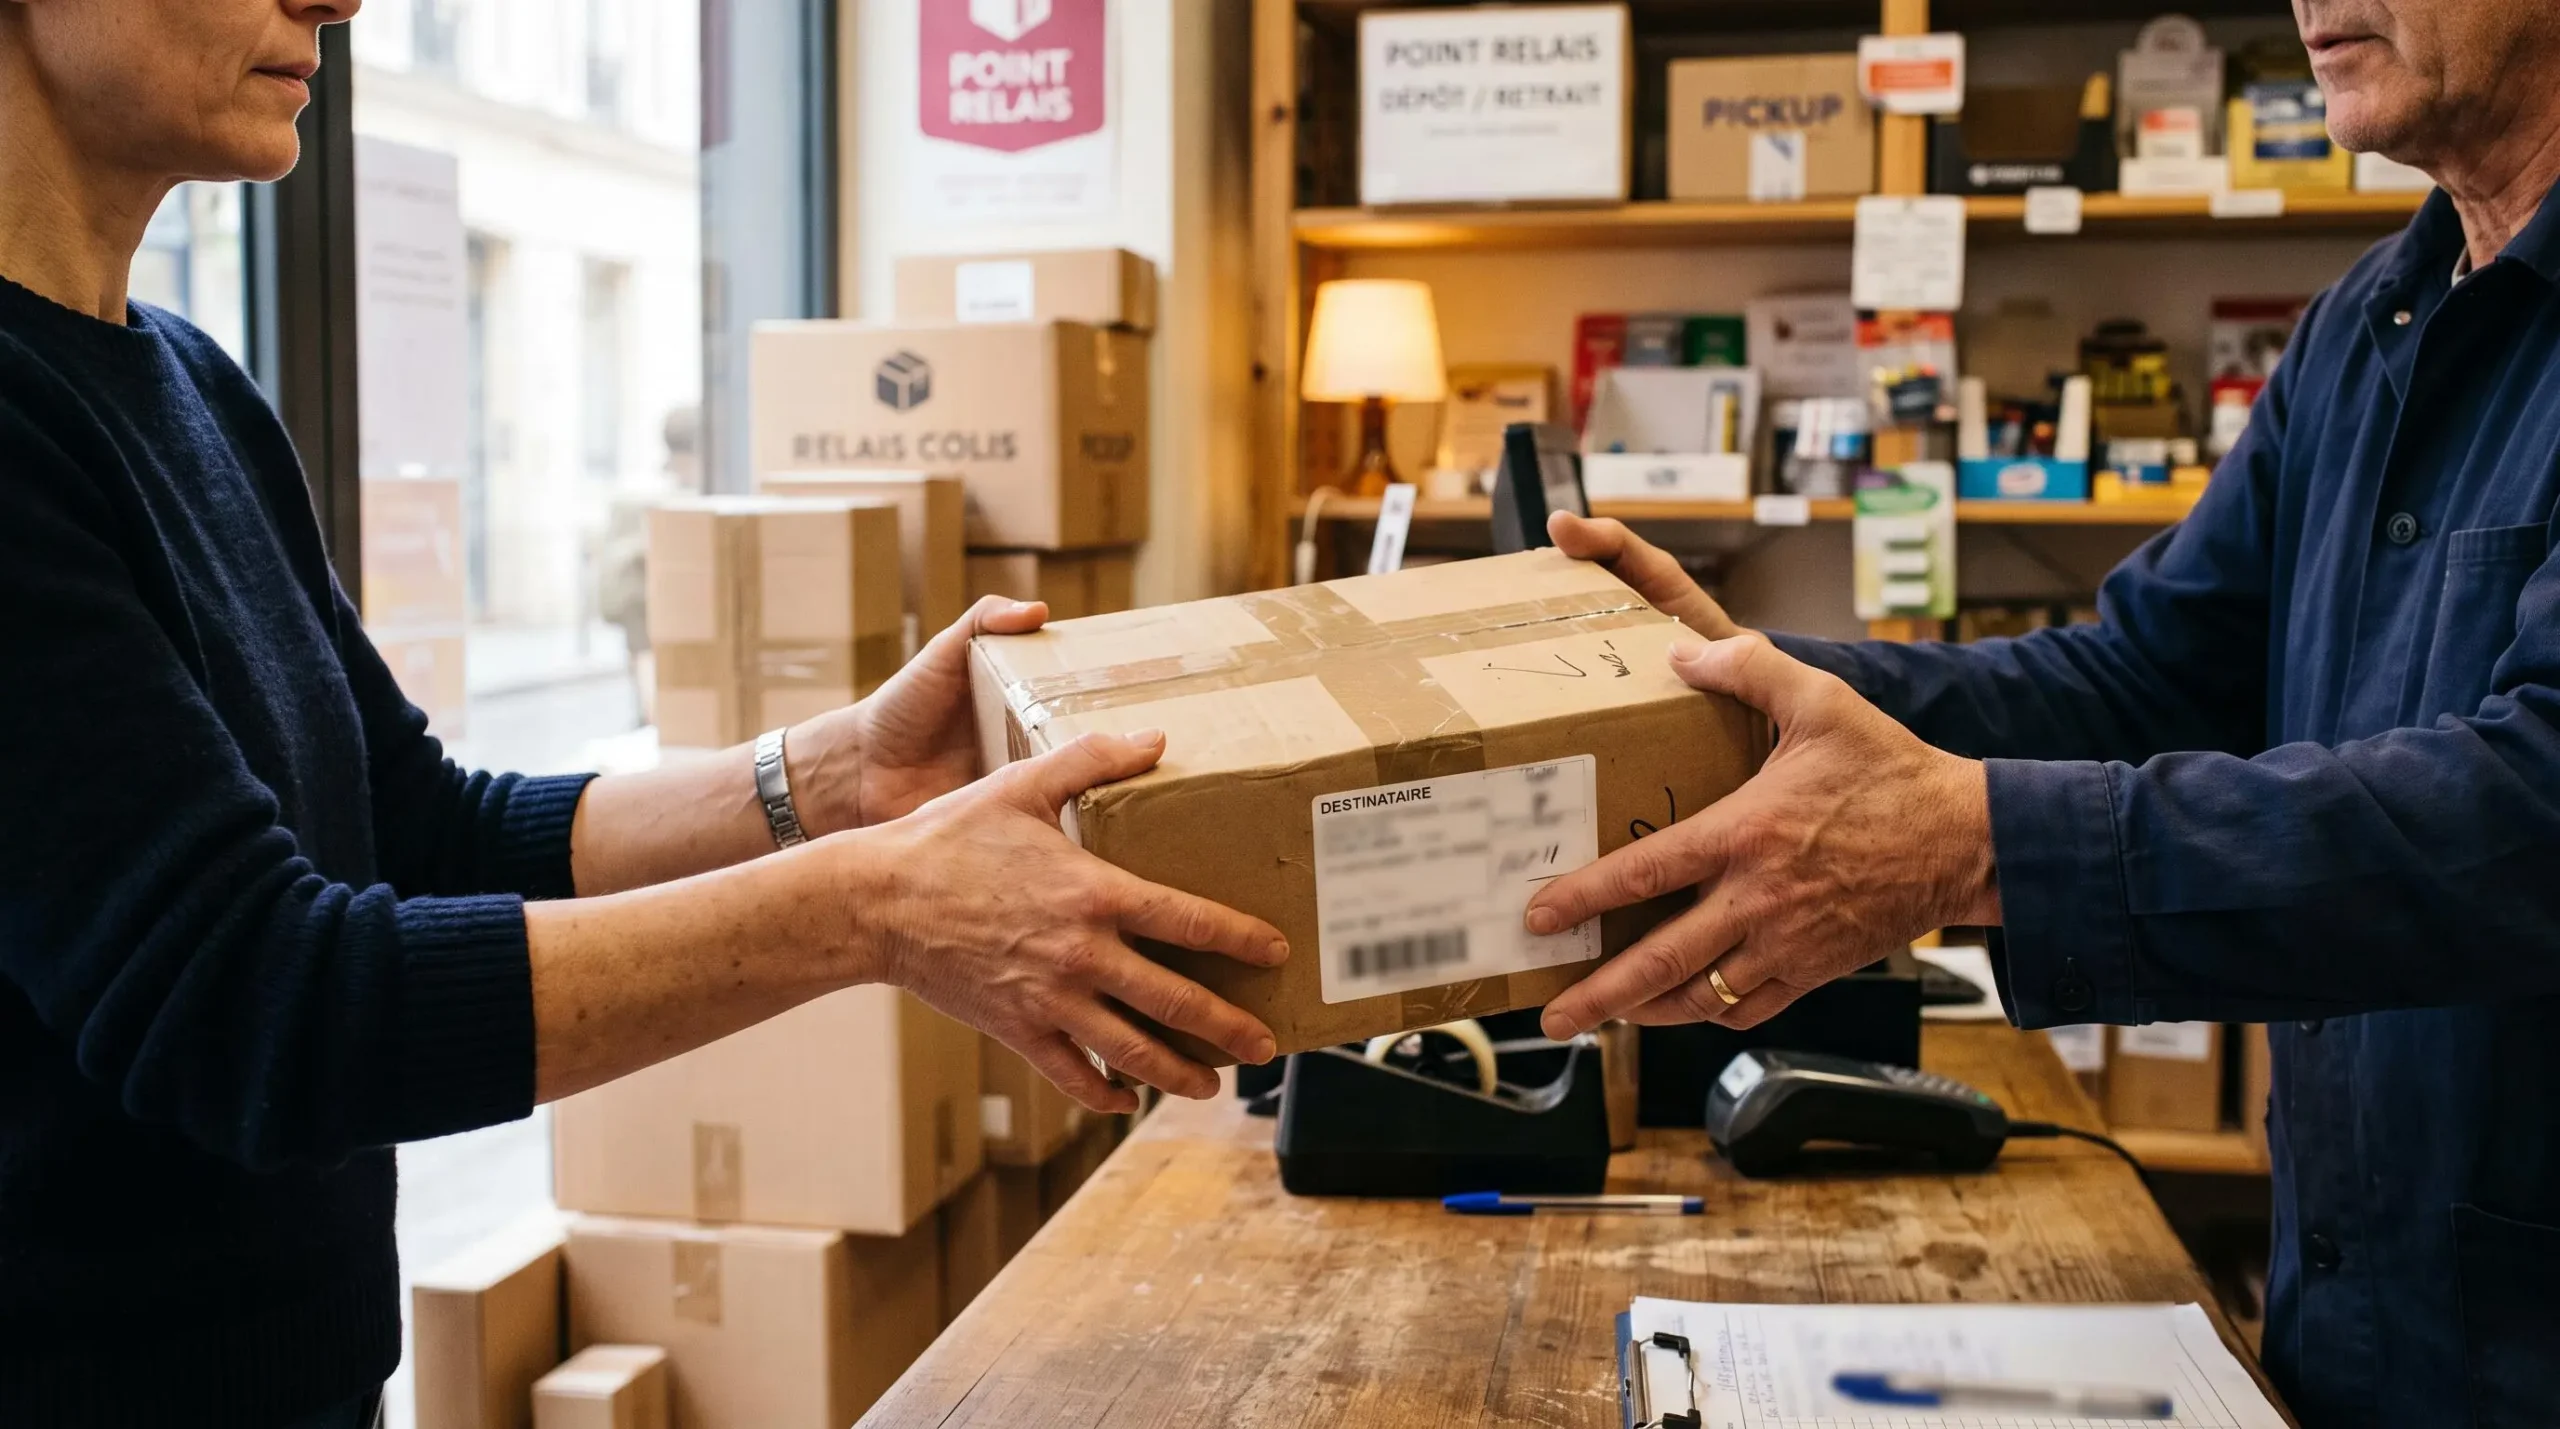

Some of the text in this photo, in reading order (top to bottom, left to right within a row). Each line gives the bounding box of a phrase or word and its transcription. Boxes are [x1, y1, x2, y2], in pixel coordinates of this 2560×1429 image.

[949, 49, 1072, 87] POINT
[1385, 34, 1600, 68] POINT RELAIS
[949, 86, 1073, 124] RELAIS
[1494, 82, 1601, 109] RETRAIT
[1703, 94, 1843, 128] PICKUP
[793, 430, 1019, 463] RELAIS COLIS
[1320, 786, 1432, 814] DESTINATAIRE
